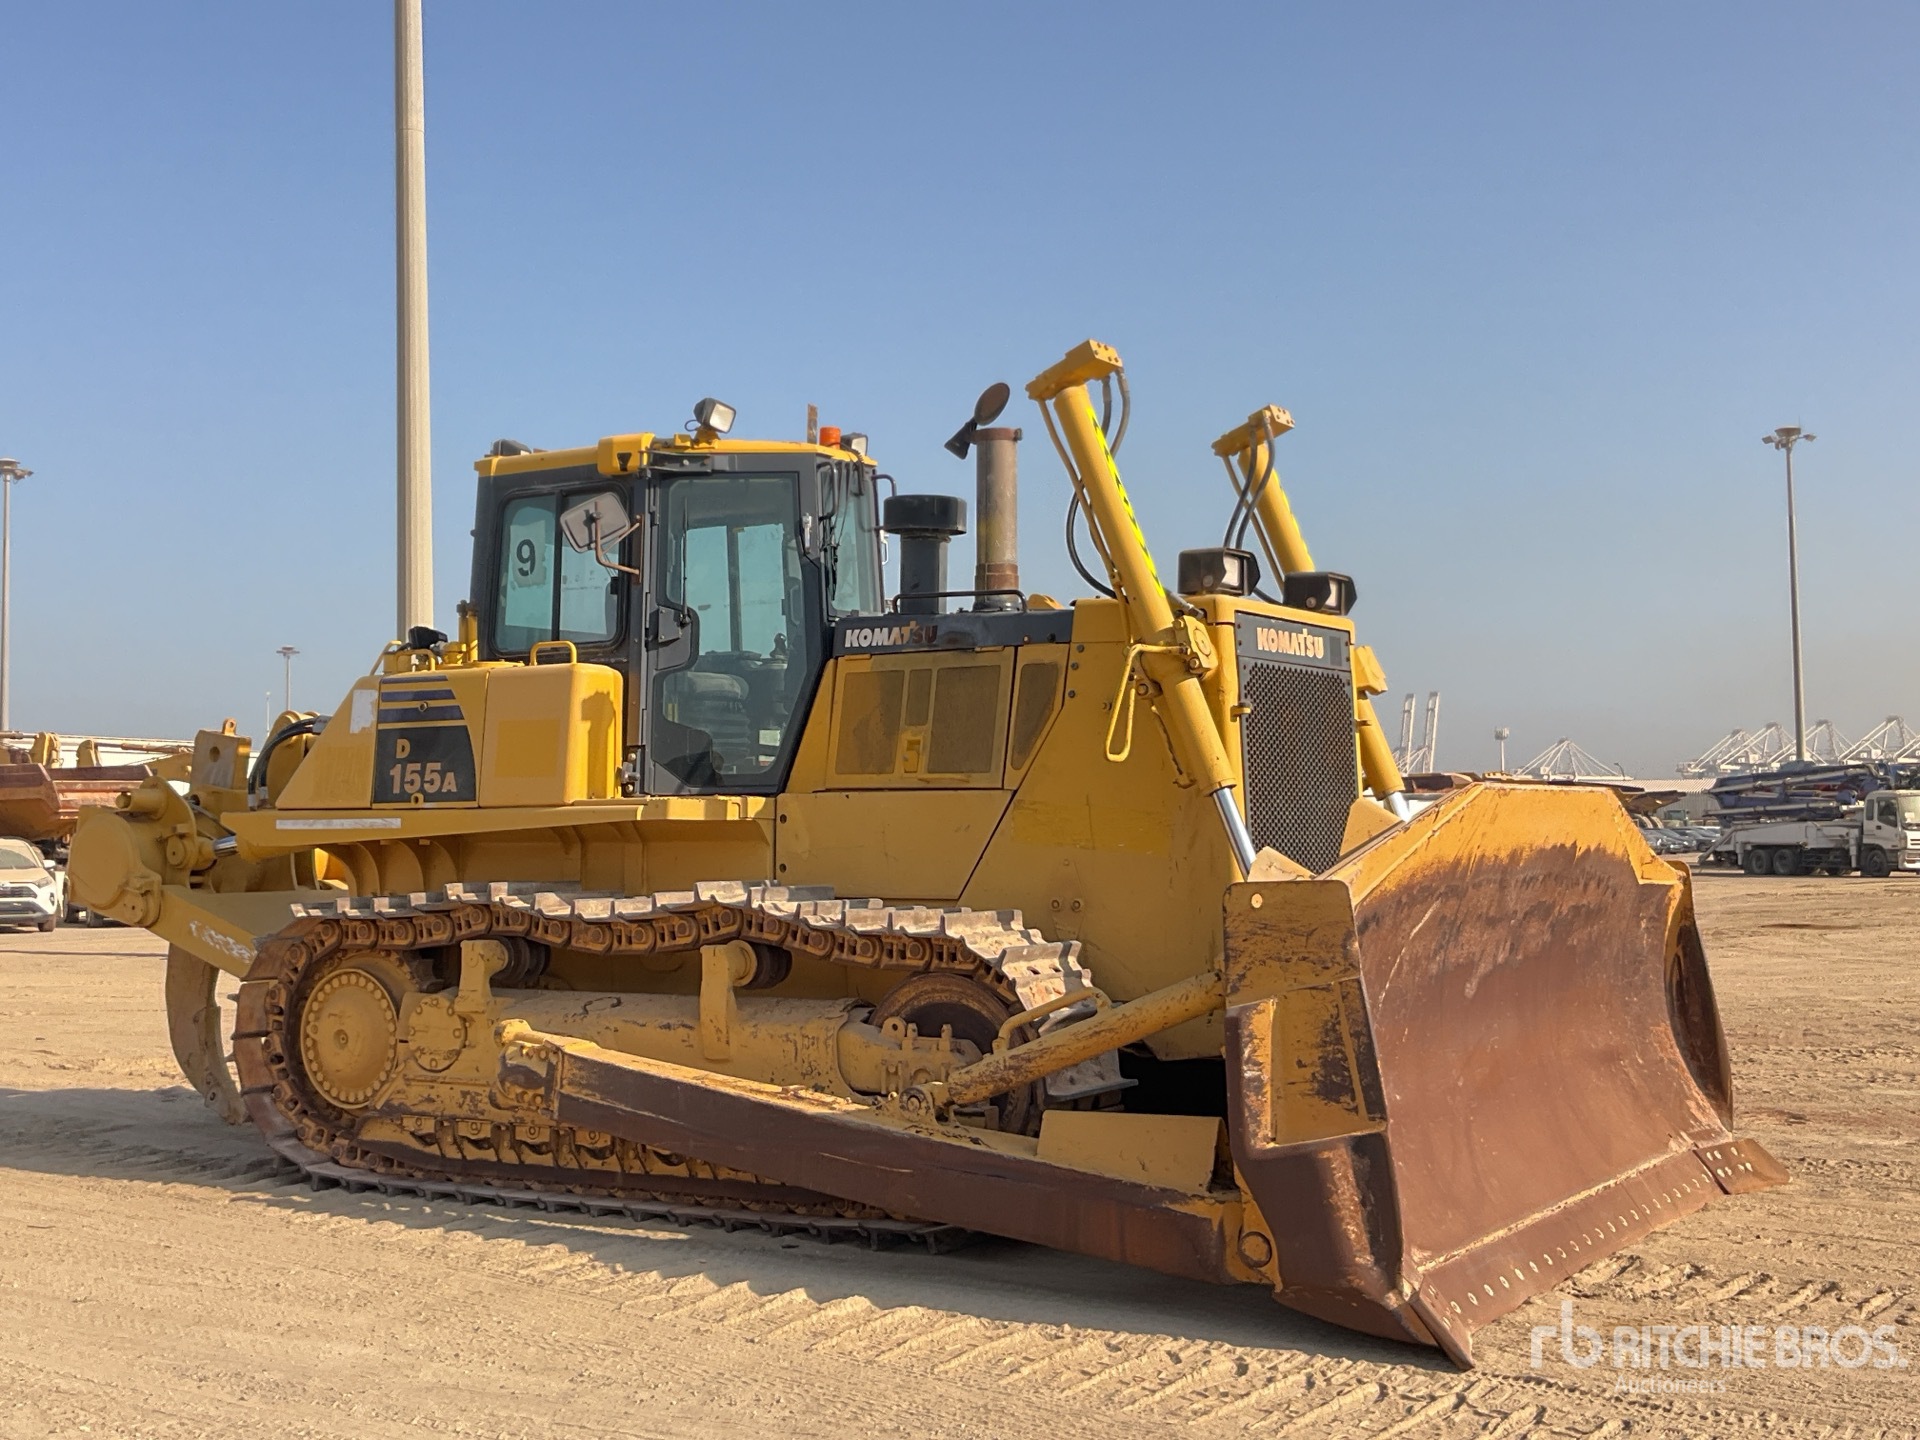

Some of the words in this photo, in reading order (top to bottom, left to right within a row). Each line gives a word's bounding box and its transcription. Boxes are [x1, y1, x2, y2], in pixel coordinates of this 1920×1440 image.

[516, 539, 536, 577] 9
[844, 620, 938, 648] KOMATSU
[1256, 627, 1324, 659] KOMATSU
[395, 738, 411, 759] D
[389, 762, 457, 794] 155A
